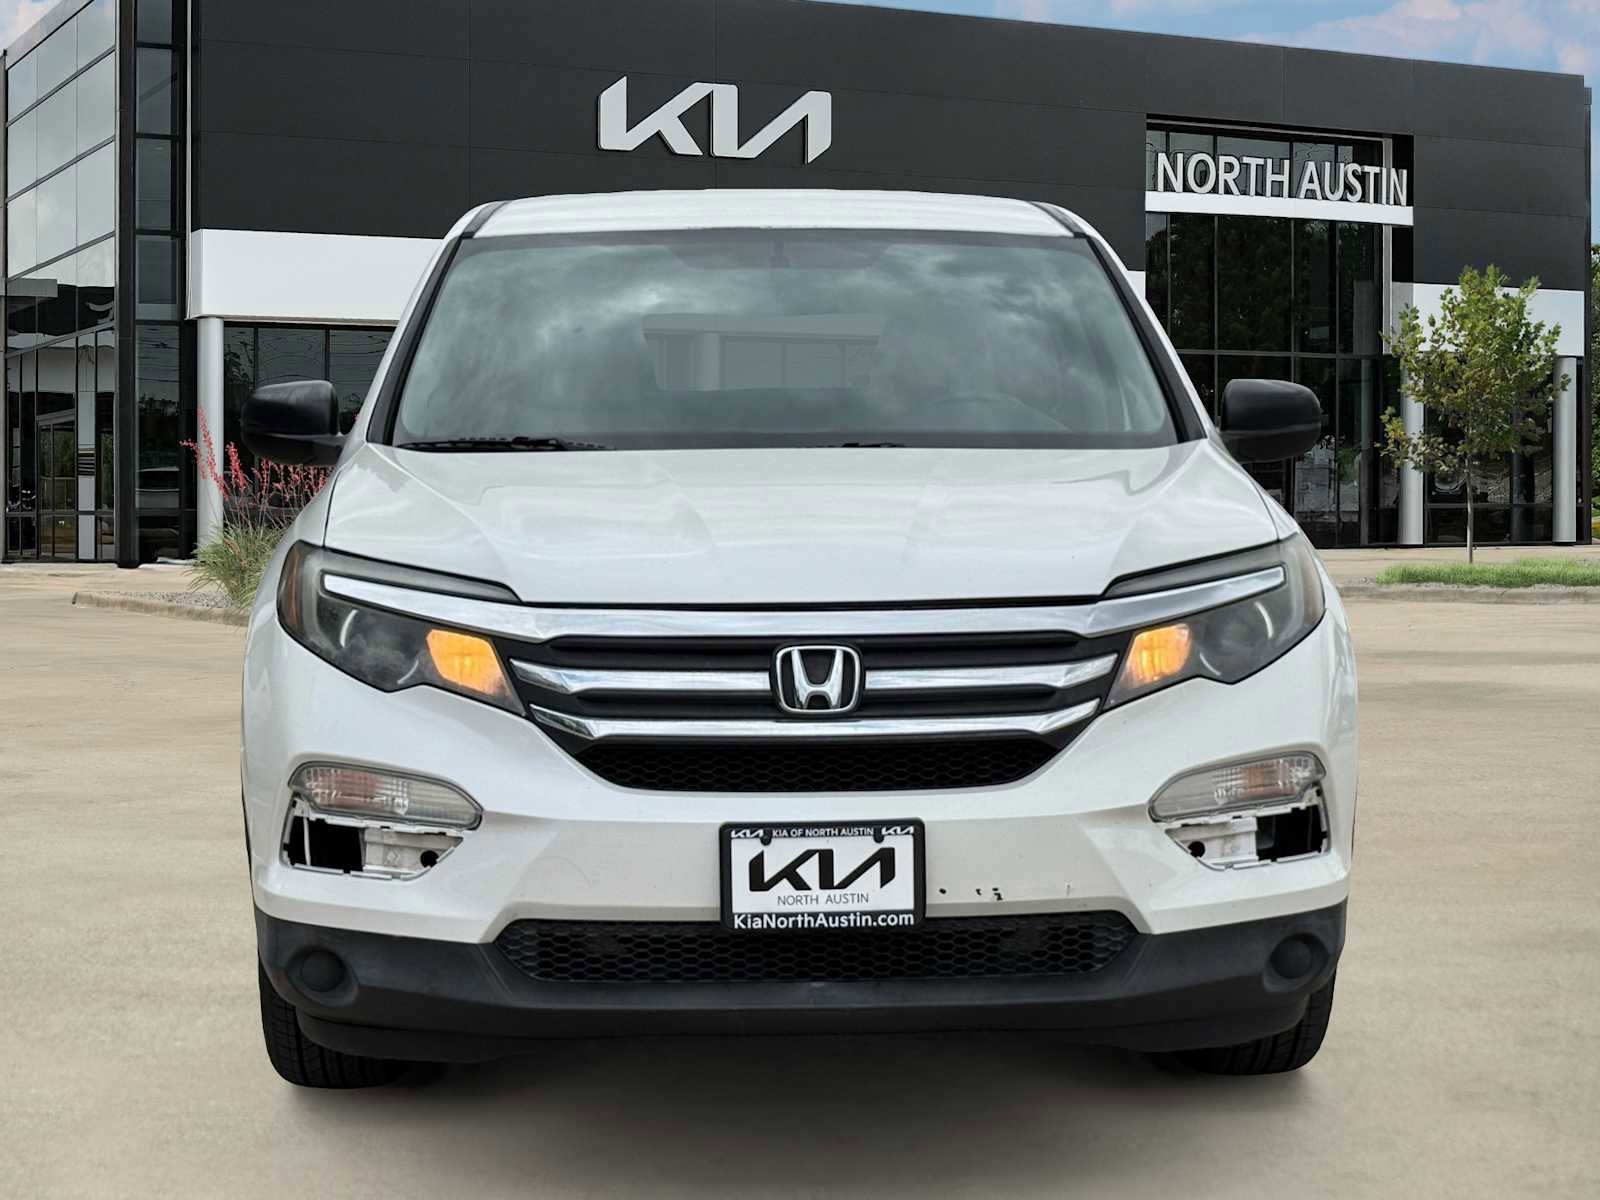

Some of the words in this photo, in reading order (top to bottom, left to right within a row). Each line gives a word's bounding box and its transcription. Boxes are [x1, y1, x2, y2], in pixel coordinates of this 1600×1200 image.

[1157, 152, 1290, 198] NORTH
[1299, 160, 1408, 206] AUSTIN
[772, 829, 788, 837] KIA
[790, 829, 803, 837] OF
[805, 828, 839, 837] NORTH
[841, 827, 874, 836] AUSTIN
[777, 895, 819, 906] NORTH
[825, 893, 869, 904] AUSTIN
[734, 912, 914, 930] KiaNorthAustin.com
